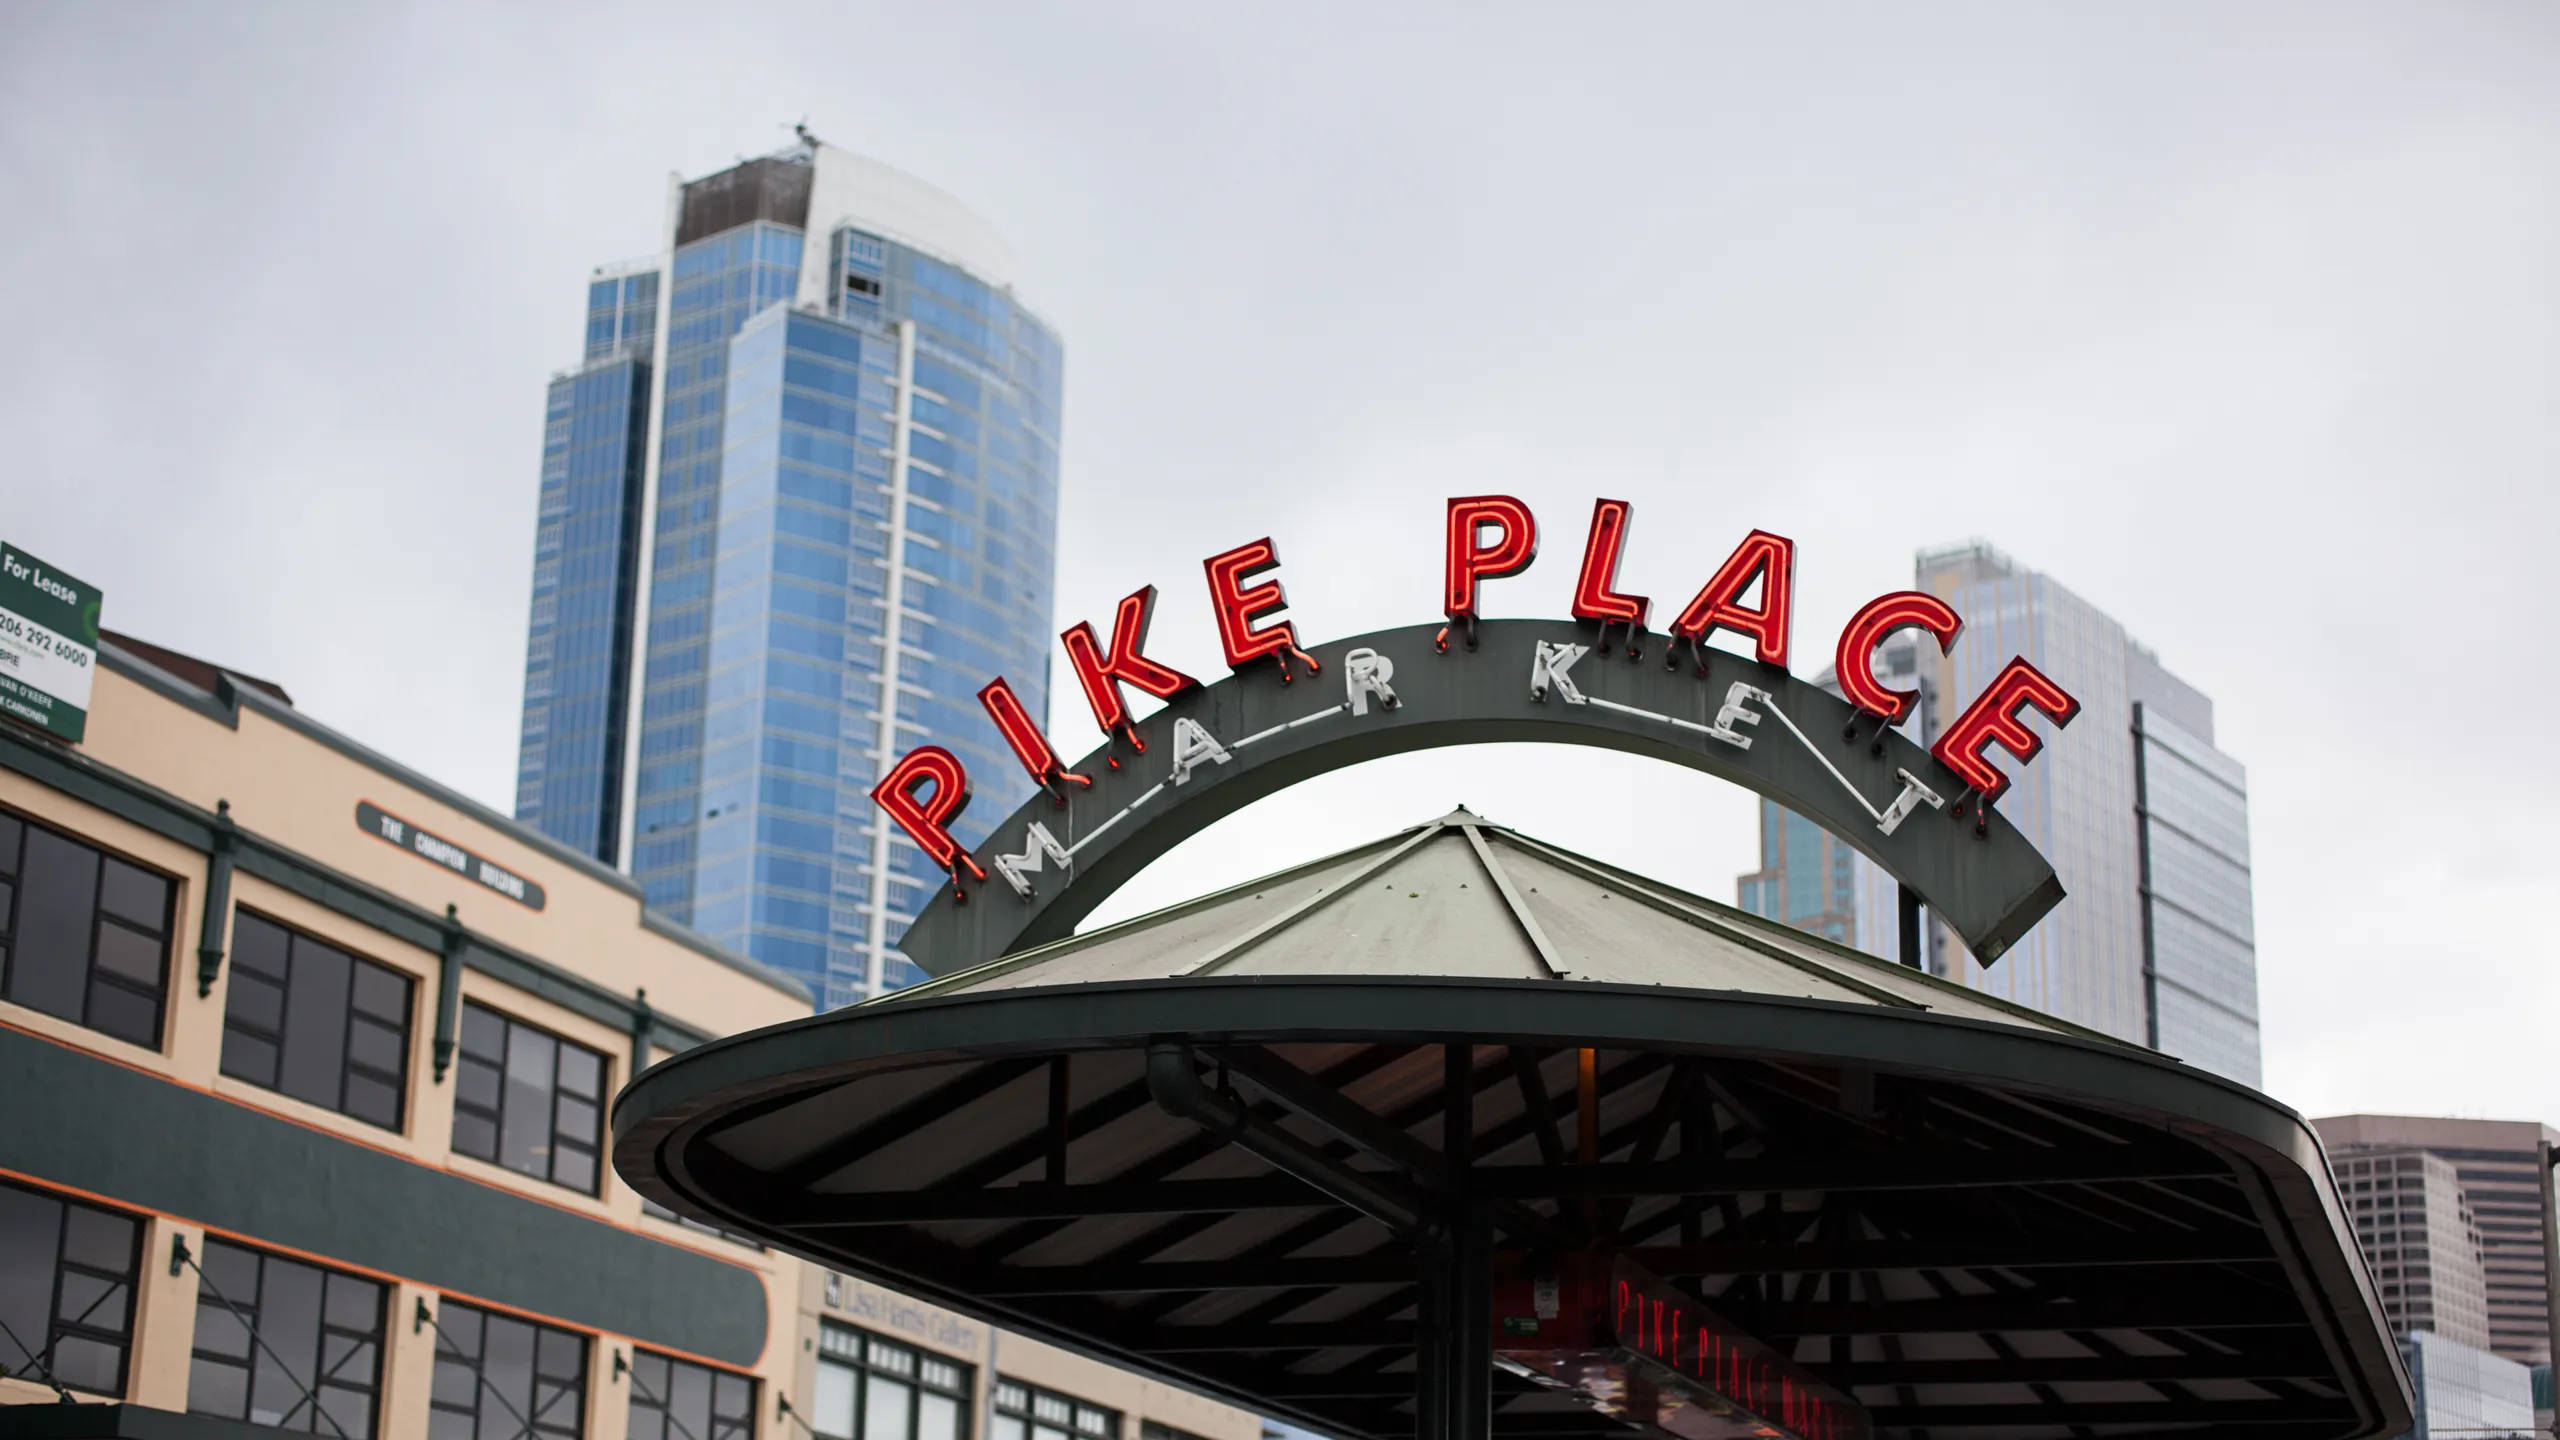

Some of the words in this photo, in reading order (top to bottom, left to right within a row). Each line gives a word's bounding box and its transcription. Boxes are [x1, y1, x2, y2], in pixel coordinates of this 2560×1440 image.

[0, 613, 22, 637] 206
[27, 627, 51, 652] 292
[55, 641, 88, 668] 6000
[4, 553, 30, 580] For
[33, 568, 78, 606] Lease
[870, 536, 1301, 872] PIKE
[1445, 495, 2081, 800] PLACE
[995, 640, 1945, 898] MARKET
[381, 815, 404, 845] THE
[415, 832, 467, 872] CHAMPION
[479, 861, 525, 900] BUILDING
[1617, 1280, 1680, 1367] PIKE
[1699, 1326, 1769, 1416] PLACE
[1782, 1374, 1855, 1440] MARK
